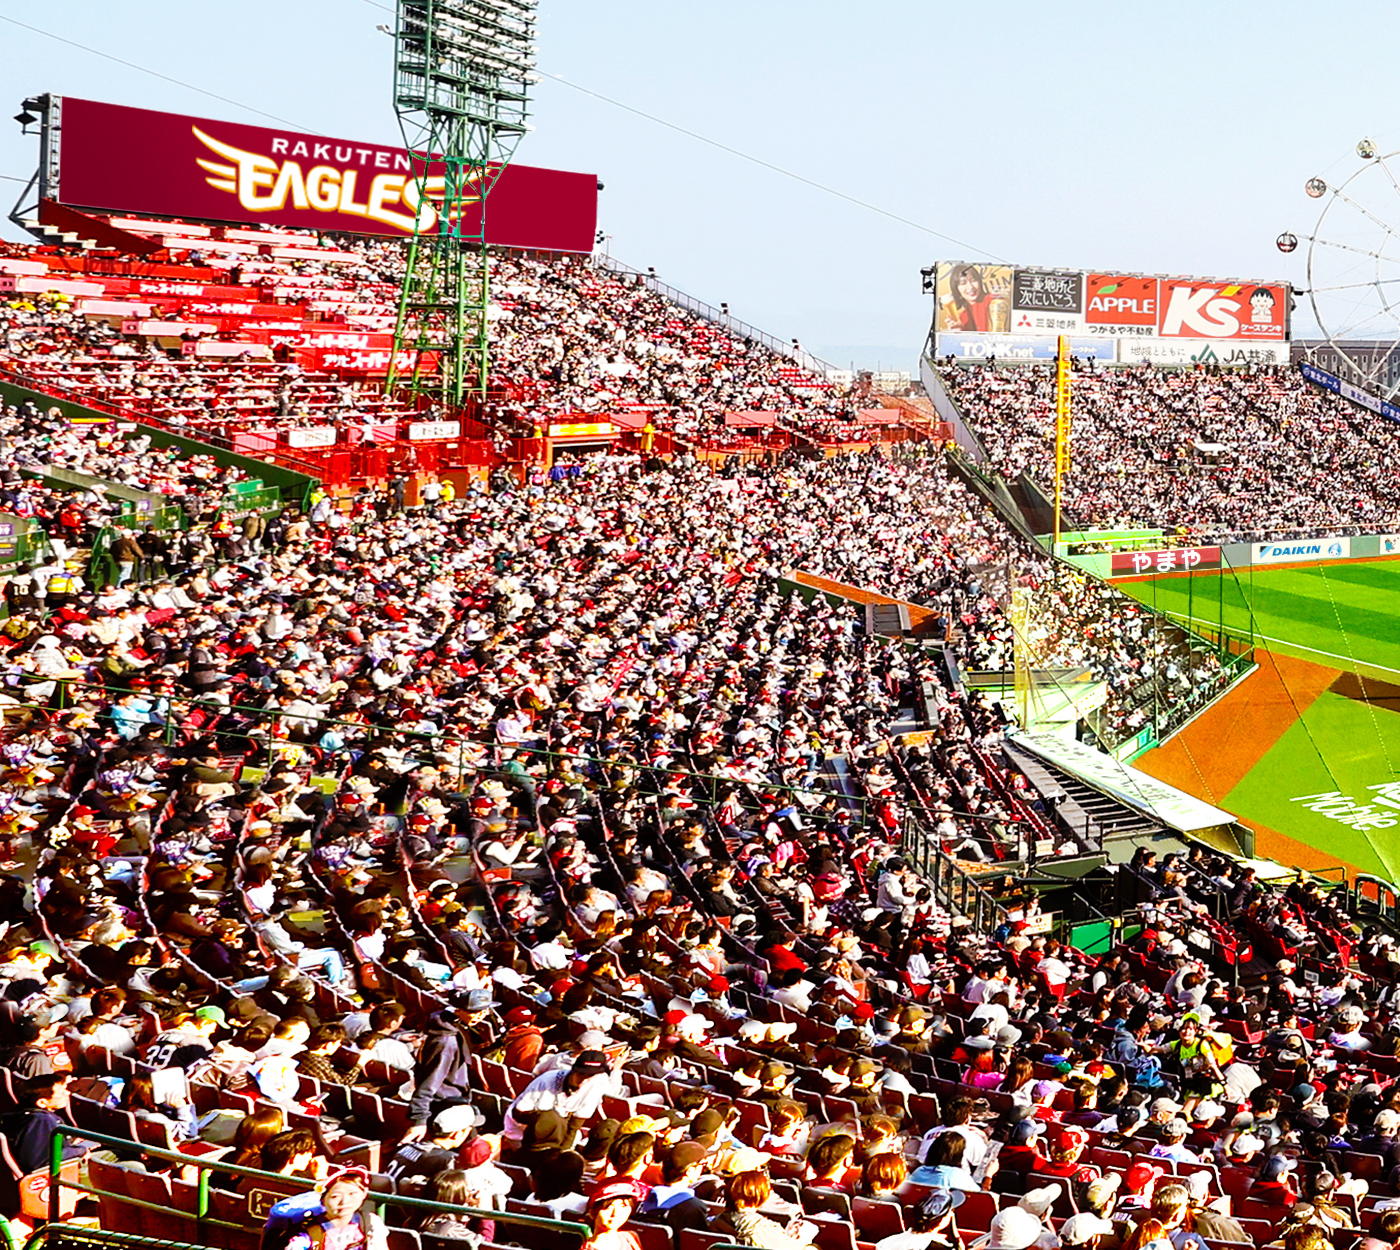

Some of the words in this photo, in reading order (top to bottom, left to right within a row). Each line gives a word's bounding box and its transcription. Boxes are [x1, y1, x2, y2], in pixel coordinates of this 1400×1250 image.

[271, 136, 412, 172] RAKUTEN
[215, 148, 460, 232] EAGLES
[1019, 275, 1077, 294] 三菱地所と
[1019, 290, 1077, 308] 次にいこう。
[1088, 296, 1155, 314] APPLE
[1035, 318, 1077, 329] 三菱地所
[1088, 325, 1154, 336] つがるや不動産
[1272, 544, 1321, 558] DAIKIN
[1132, 550, 1201, 573] やまや
[1290, 791, 1399, 831] Mobile
